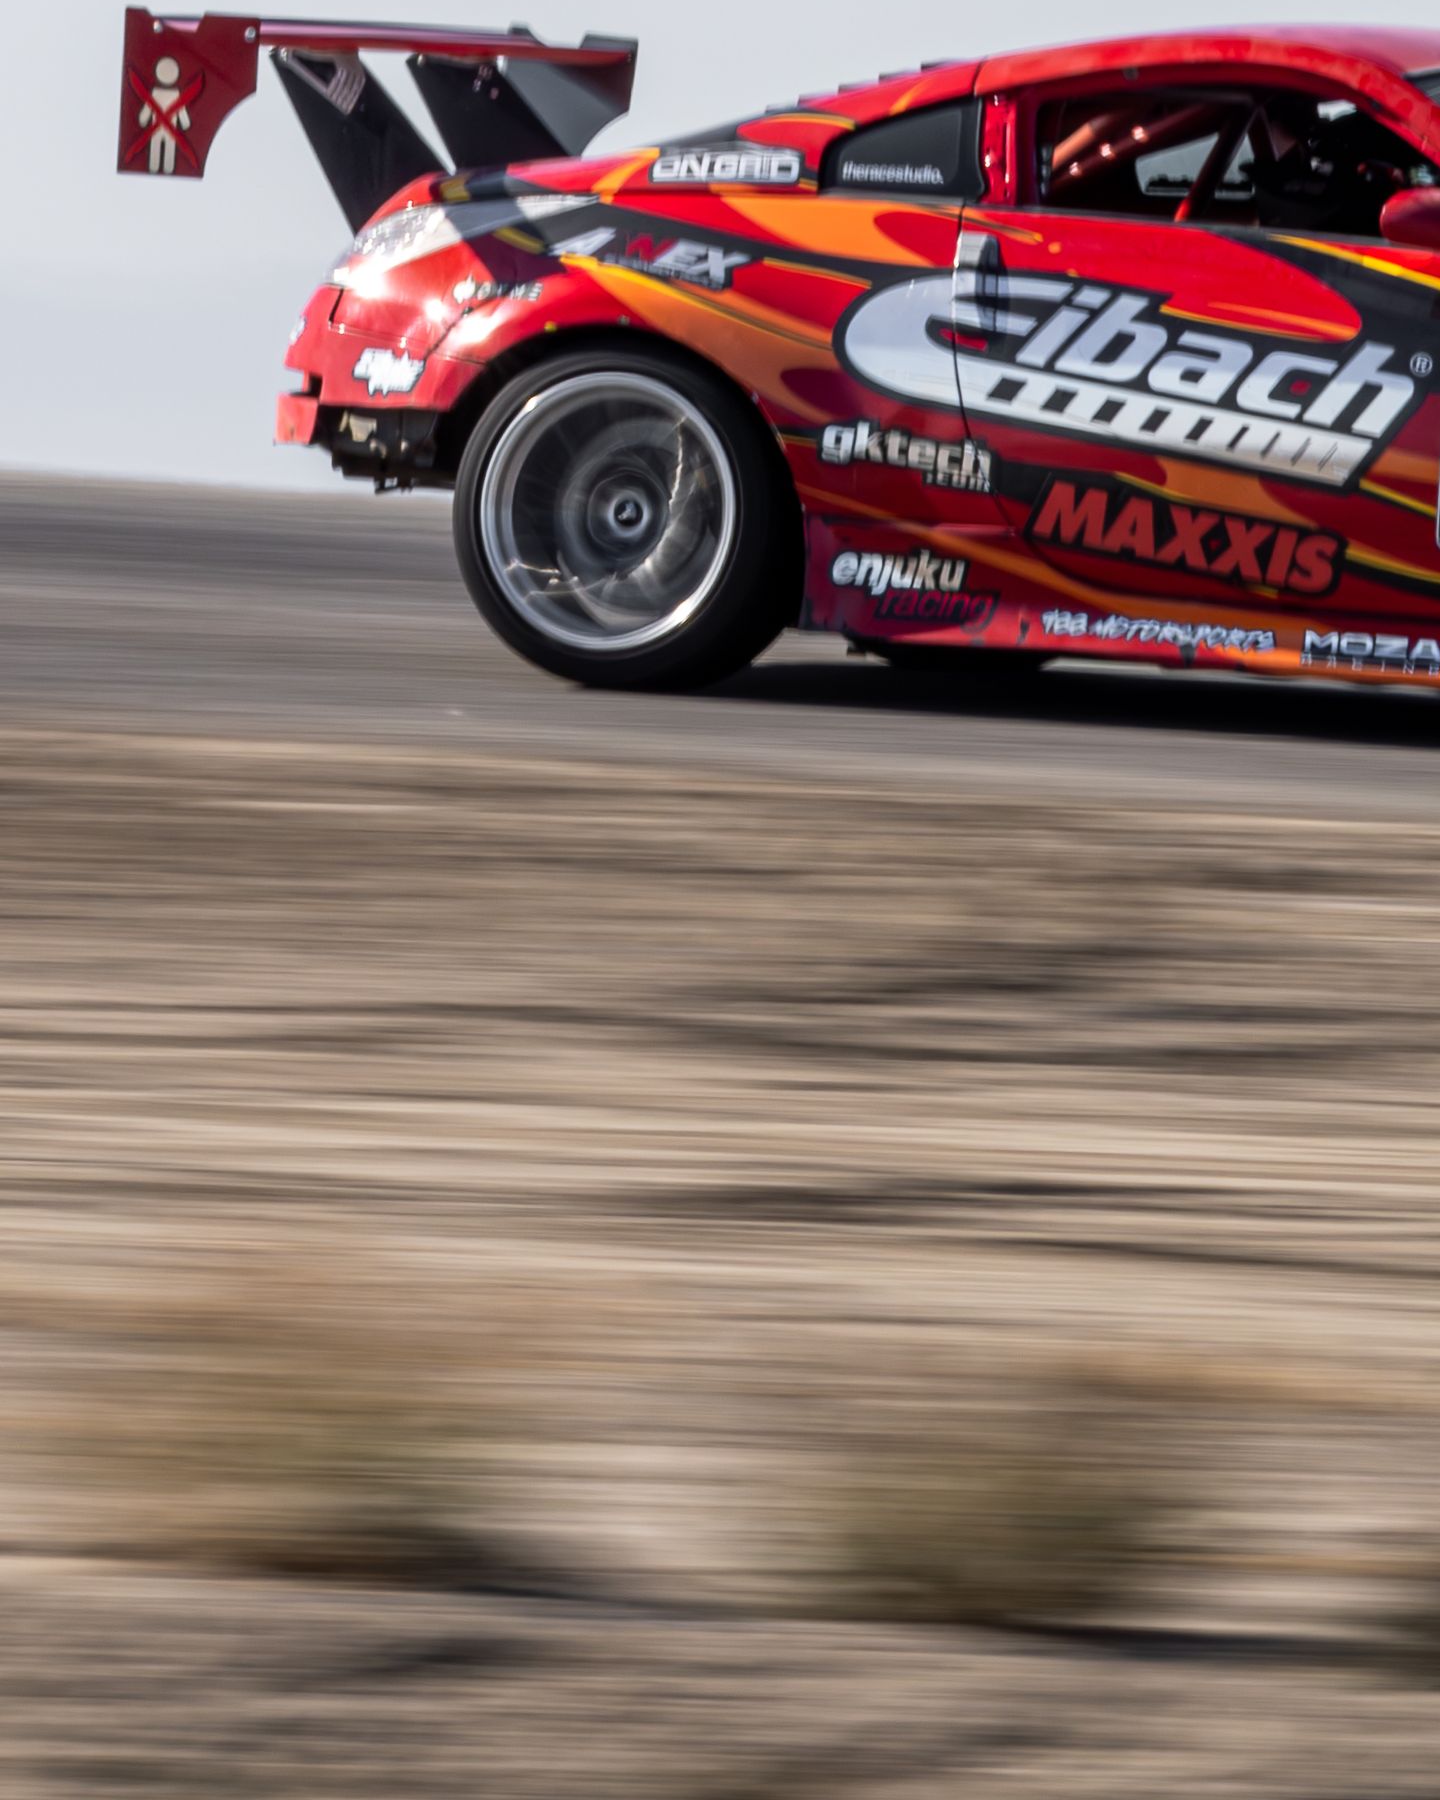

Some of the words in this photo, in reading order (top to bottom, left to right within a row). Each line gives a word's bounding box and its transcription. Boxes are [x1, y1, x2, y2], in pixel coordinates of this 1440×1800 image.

[845, 272, 1416, 488] Eibach
[832, 550, 965, 595] enjuku
[1034, 482, 1338, 592] MAXXIS
